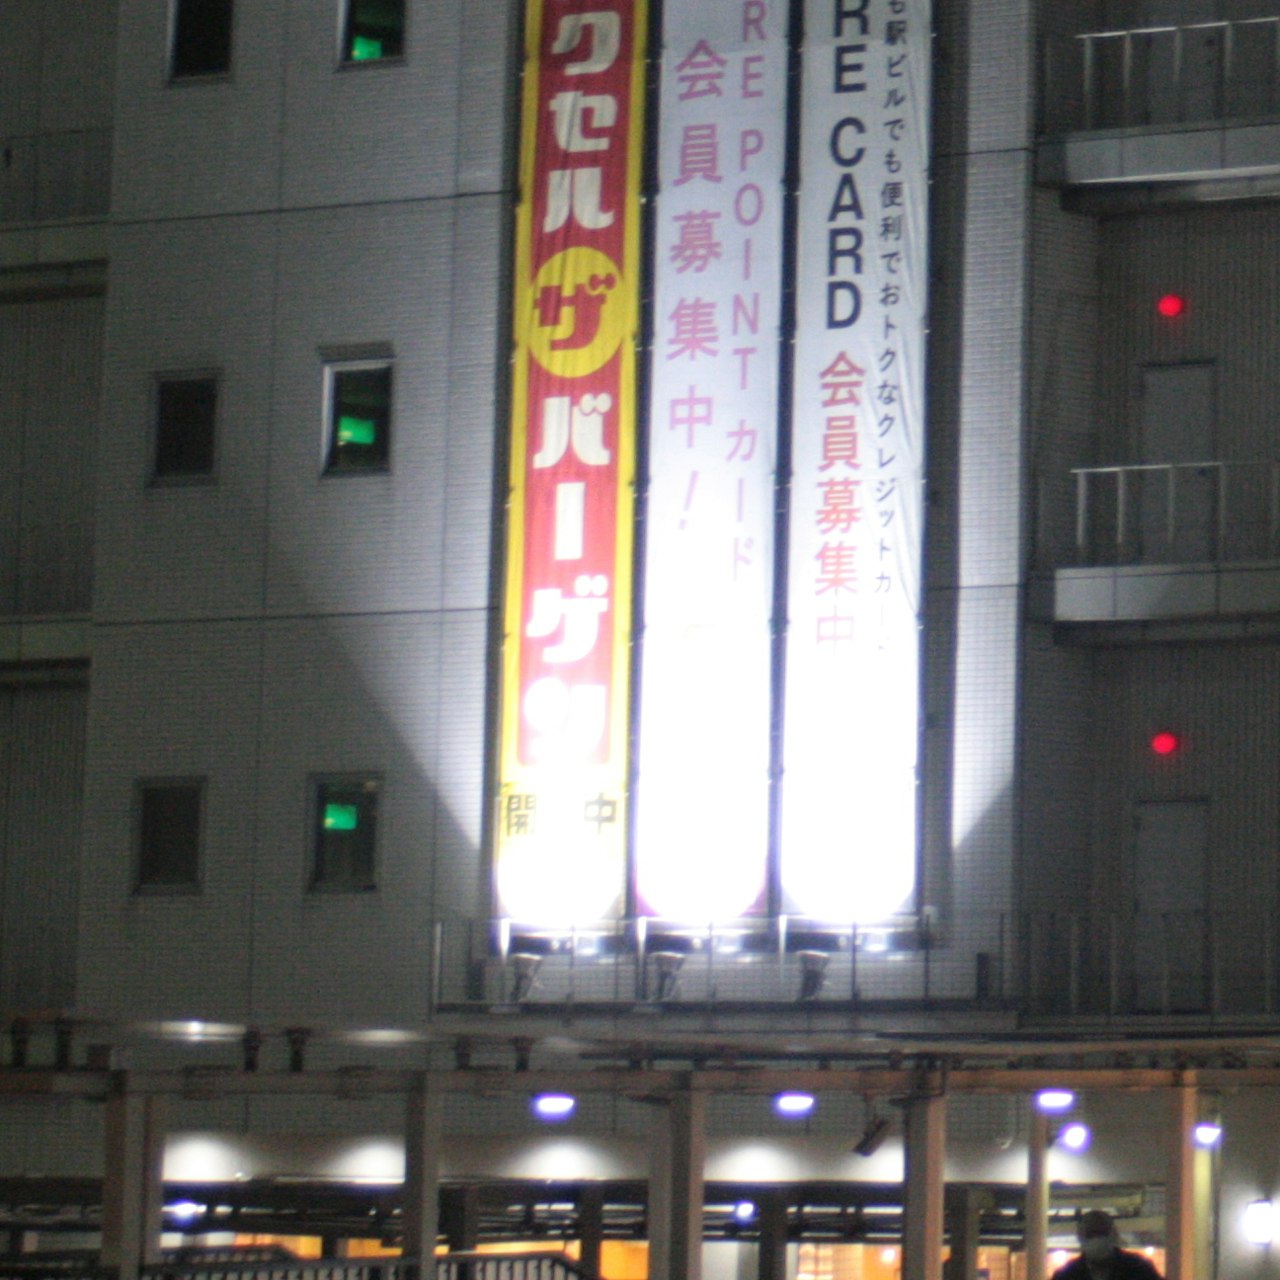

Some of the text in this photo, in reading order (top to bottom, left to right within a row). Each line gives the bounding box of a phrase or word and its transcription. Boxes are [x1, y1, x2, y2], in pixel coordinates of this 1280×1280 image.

[730, 129, 765, 391] POINT
[825, 117, 867, 329] CARD
[724, 418, 758, 582] カード
[813, 350, 867, 657] 会員募集中
[506, 789, 618, 837] 開中
